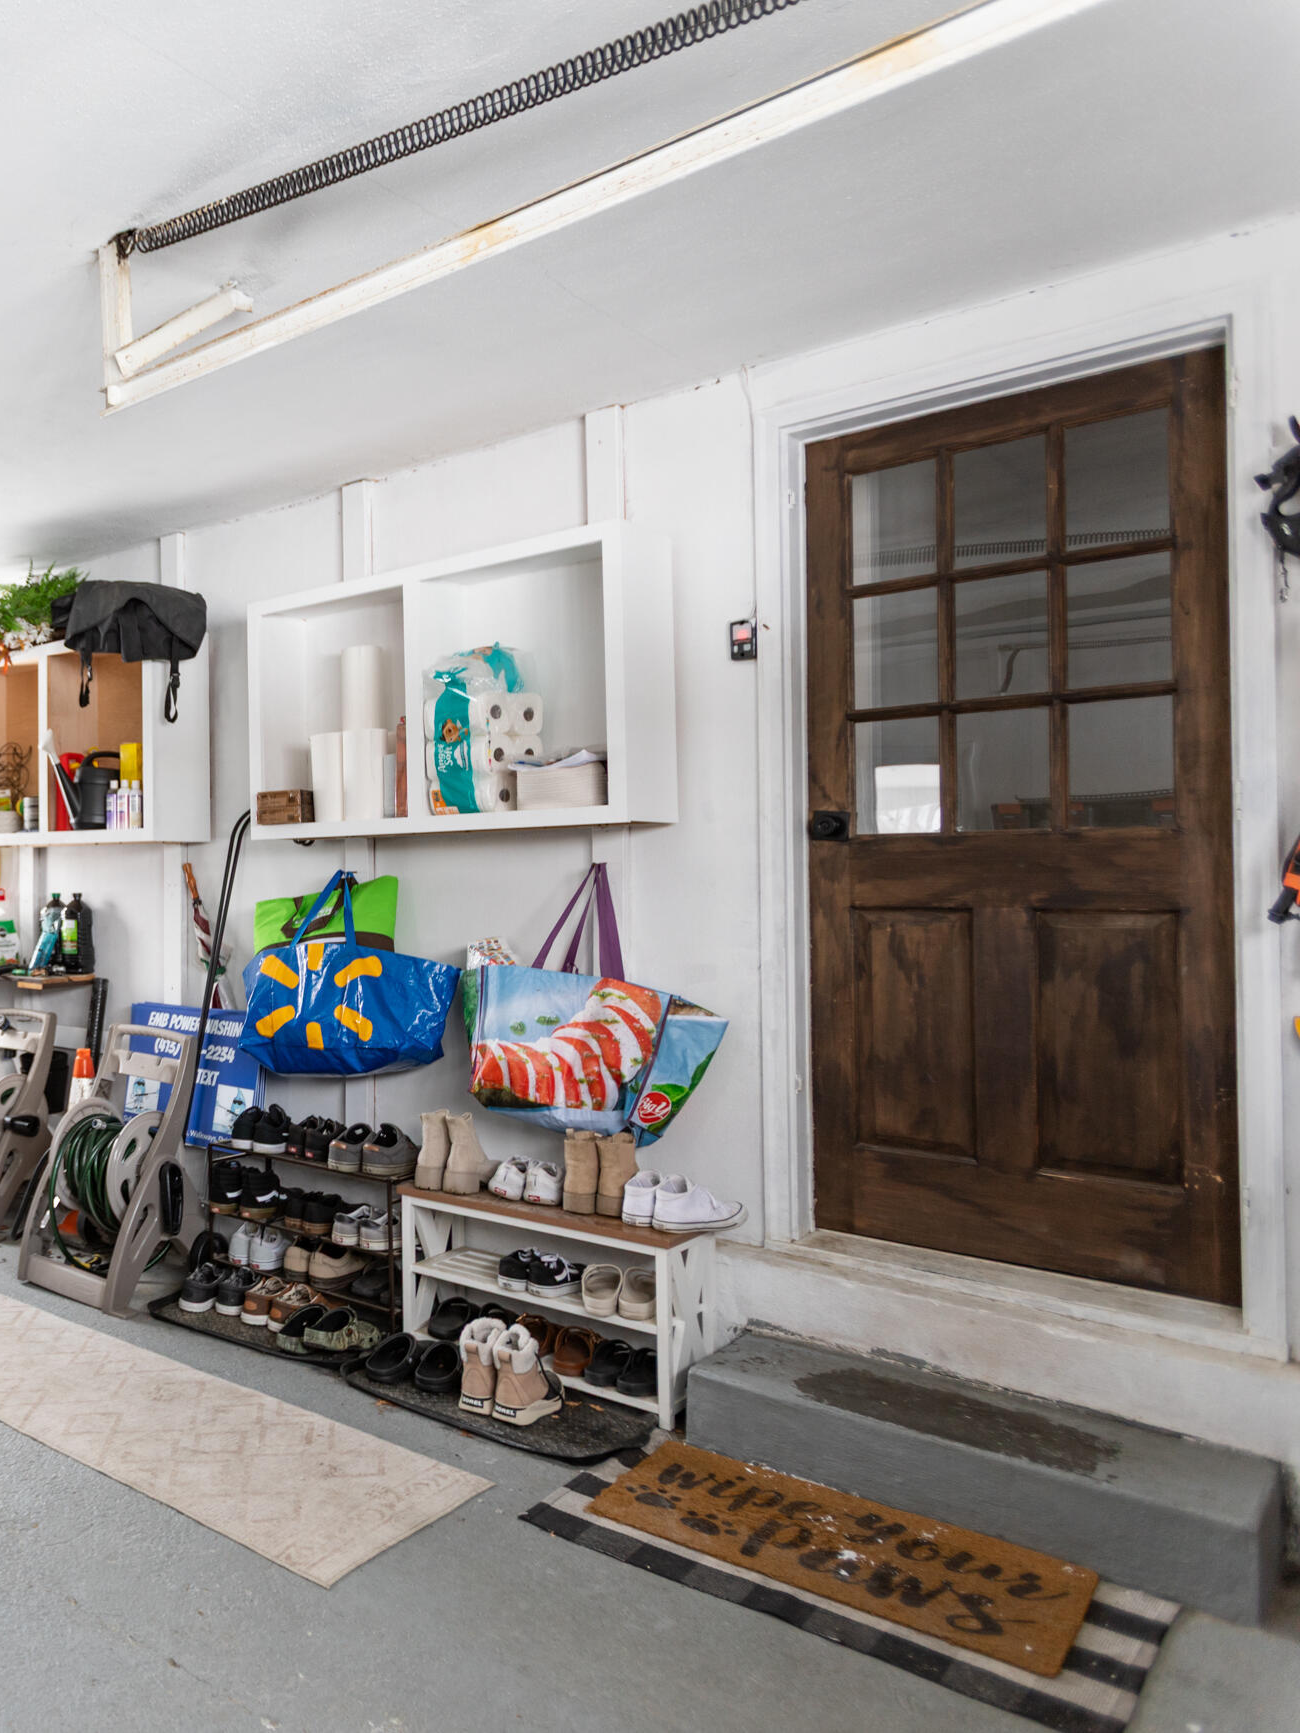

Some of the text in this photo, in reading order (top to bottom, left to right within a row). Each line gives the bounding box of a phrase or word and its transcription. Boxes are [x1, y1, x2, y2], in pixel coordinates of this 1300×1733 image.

[148, 1011, 169, 1027] EMB
[204, 1018, 244, 1038] WASHIN
[196, 1069, 219, 1086] TEXT
[656, 1463, 1070, 1601] wipe your
[739, 1518, 1038, 1637] paws
